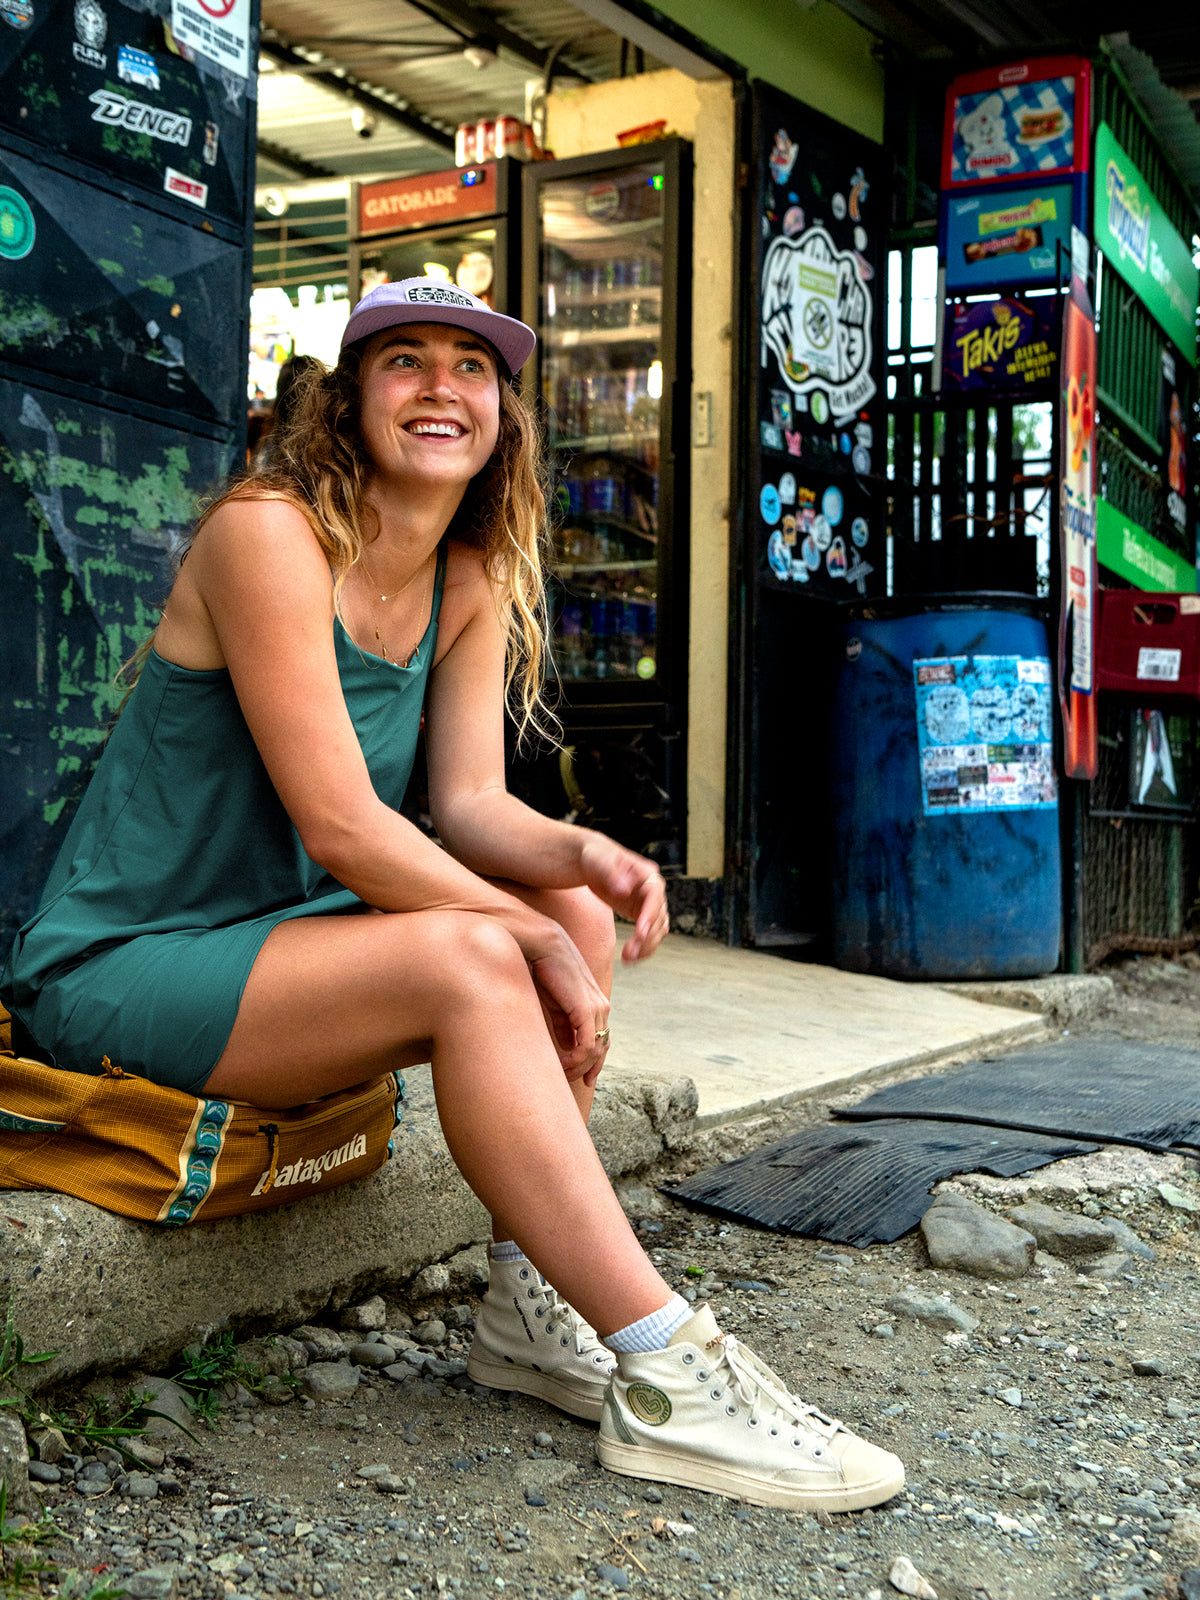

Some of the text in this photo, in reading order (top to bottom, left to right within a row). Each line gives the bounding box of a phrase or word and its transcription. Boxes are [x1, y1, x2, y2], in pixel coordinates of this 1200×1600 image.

[90, 91, 191, 143] DENGA
[365, 184, 458, 218] GATORADE
[956, 315, 1021, 378] Takis
[250, 1132, 367, 1197] patagonia
